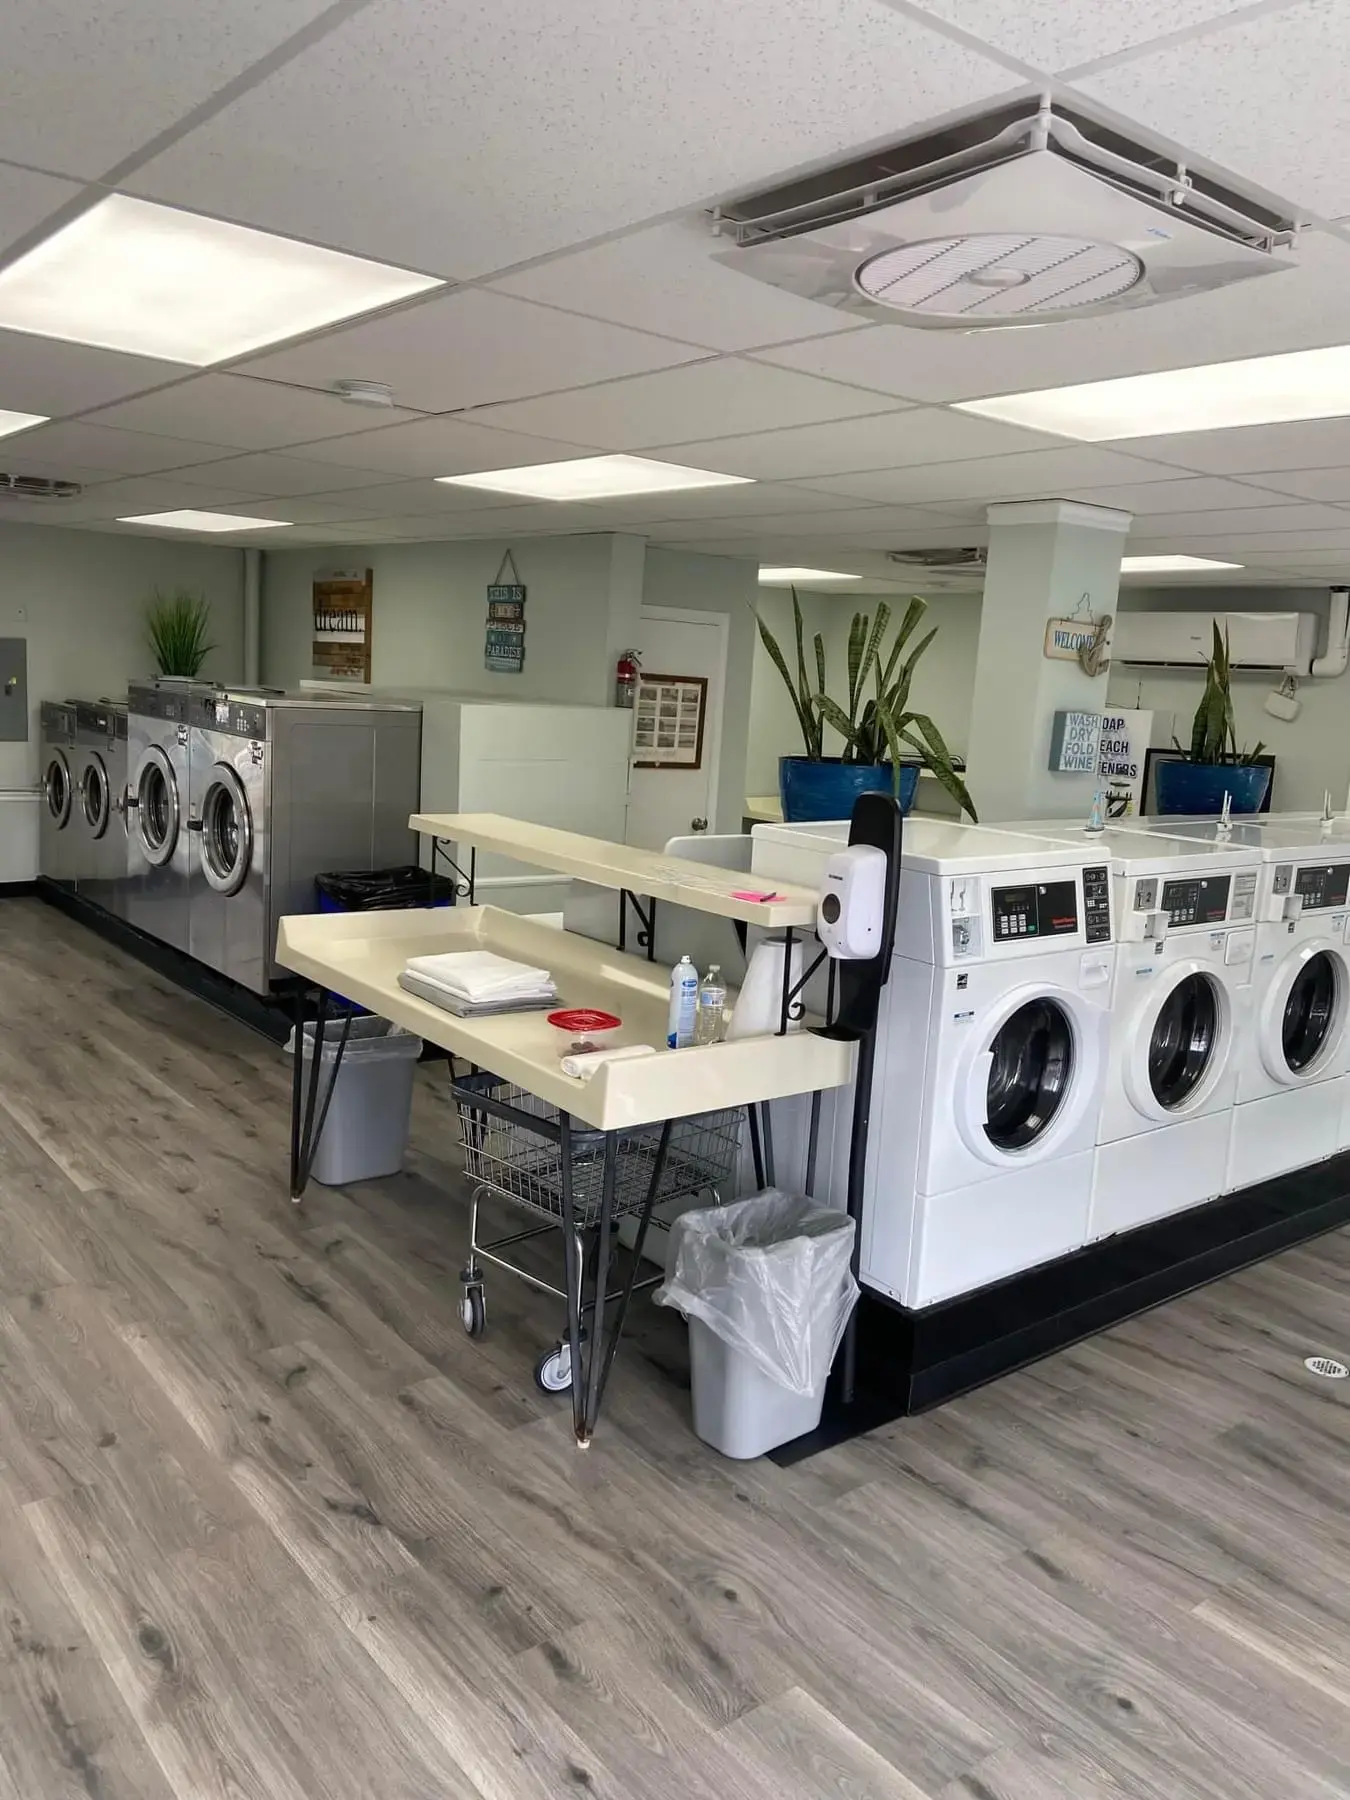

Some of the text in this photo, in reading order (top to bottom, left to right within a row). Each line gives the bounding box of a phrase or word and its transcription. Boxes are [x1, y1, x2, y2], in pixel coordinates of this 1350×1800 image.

[314, 598, 358, 632] dream
[1054, 630, 1094, 651] WELCOME
[486, 645, 521, 658] PARADISE
[1069, 714, 1098, 727] WASH
[1102, 717, 1124, 731] OAP
[1070, 727, 1093, 741] DRY
[1064, 742, 1094, 755] FOLD
[1099, 739, 1129, 753] EACH
[1063, 756, 1093, 769] WINE
